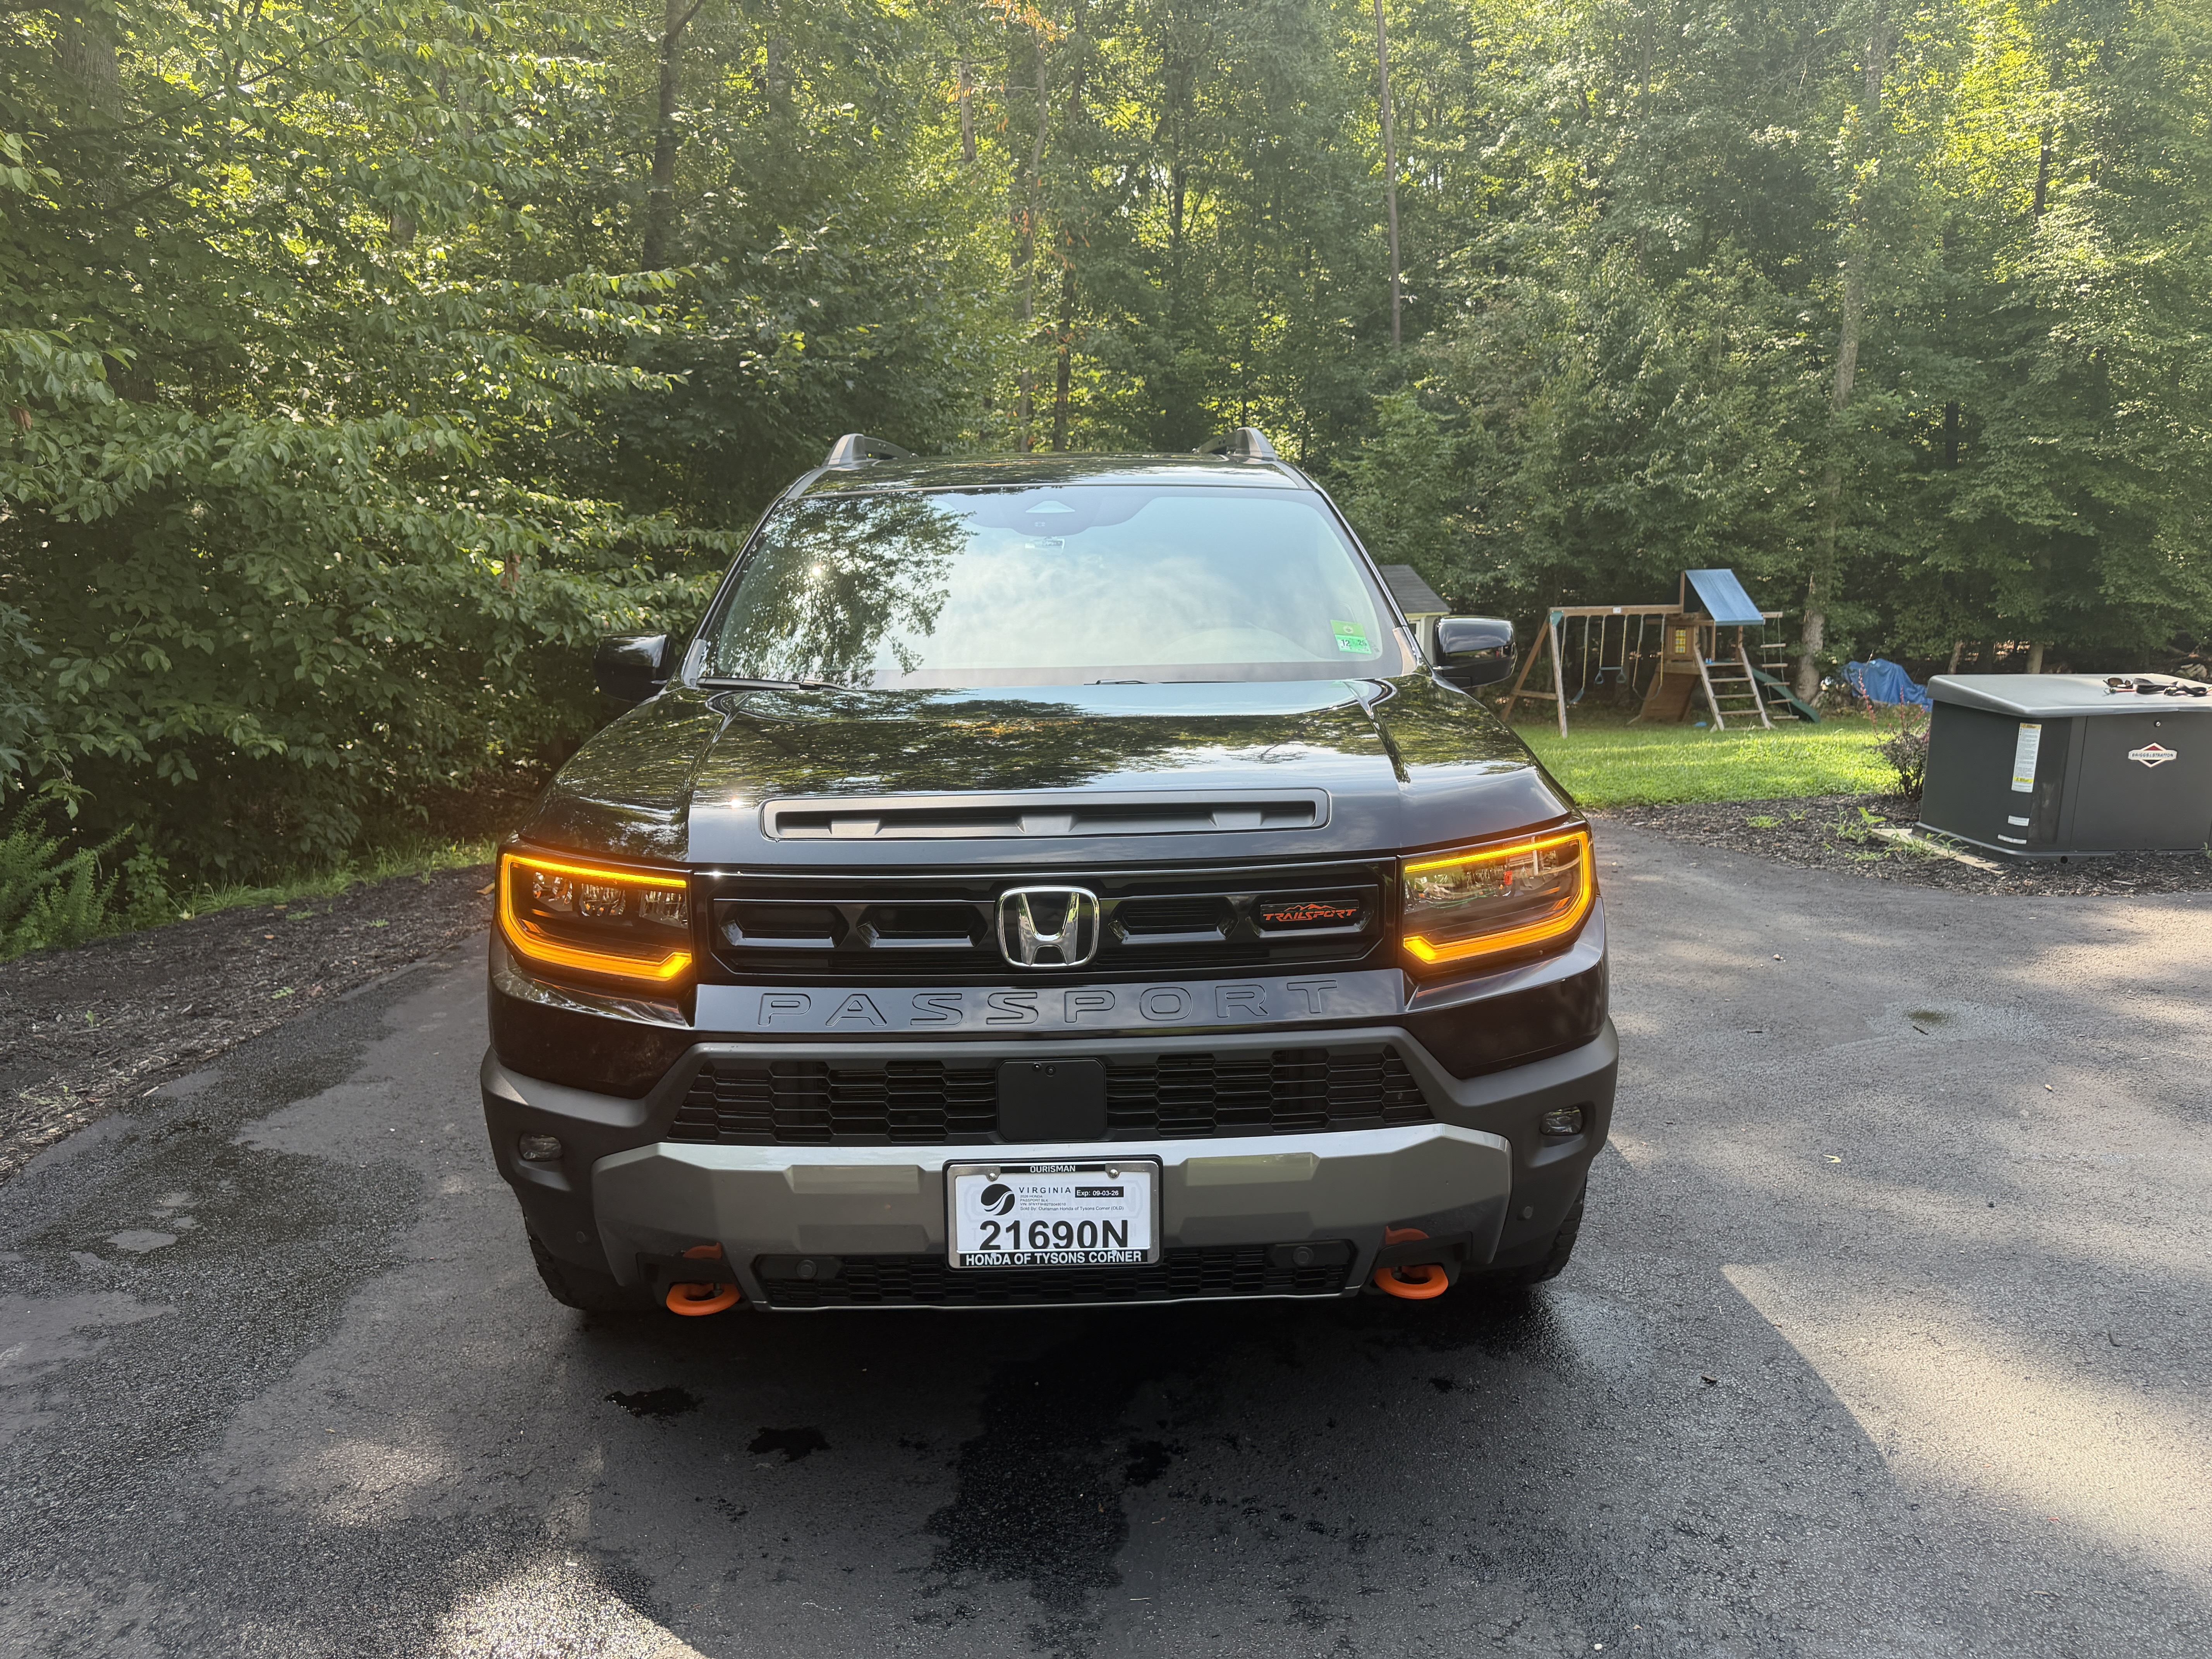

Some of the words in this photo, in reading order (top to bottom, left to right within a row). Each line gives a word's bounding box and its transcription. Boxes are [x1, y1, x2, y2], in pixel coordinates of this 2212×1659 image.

[1263, 909, 1357, 922] TRAILSPORT
[758, 980, 1338, 1027] PASSPORT
[979, 1219, 1128, 1250] 21690N
[966, 1254, 1011, 1266] HONDA
[1014, 1253, 1031, 1264] OF
[1034, 1252, 1085, 1264] TYSONS
[1089, 1251, 1142, 1263] CORNER
